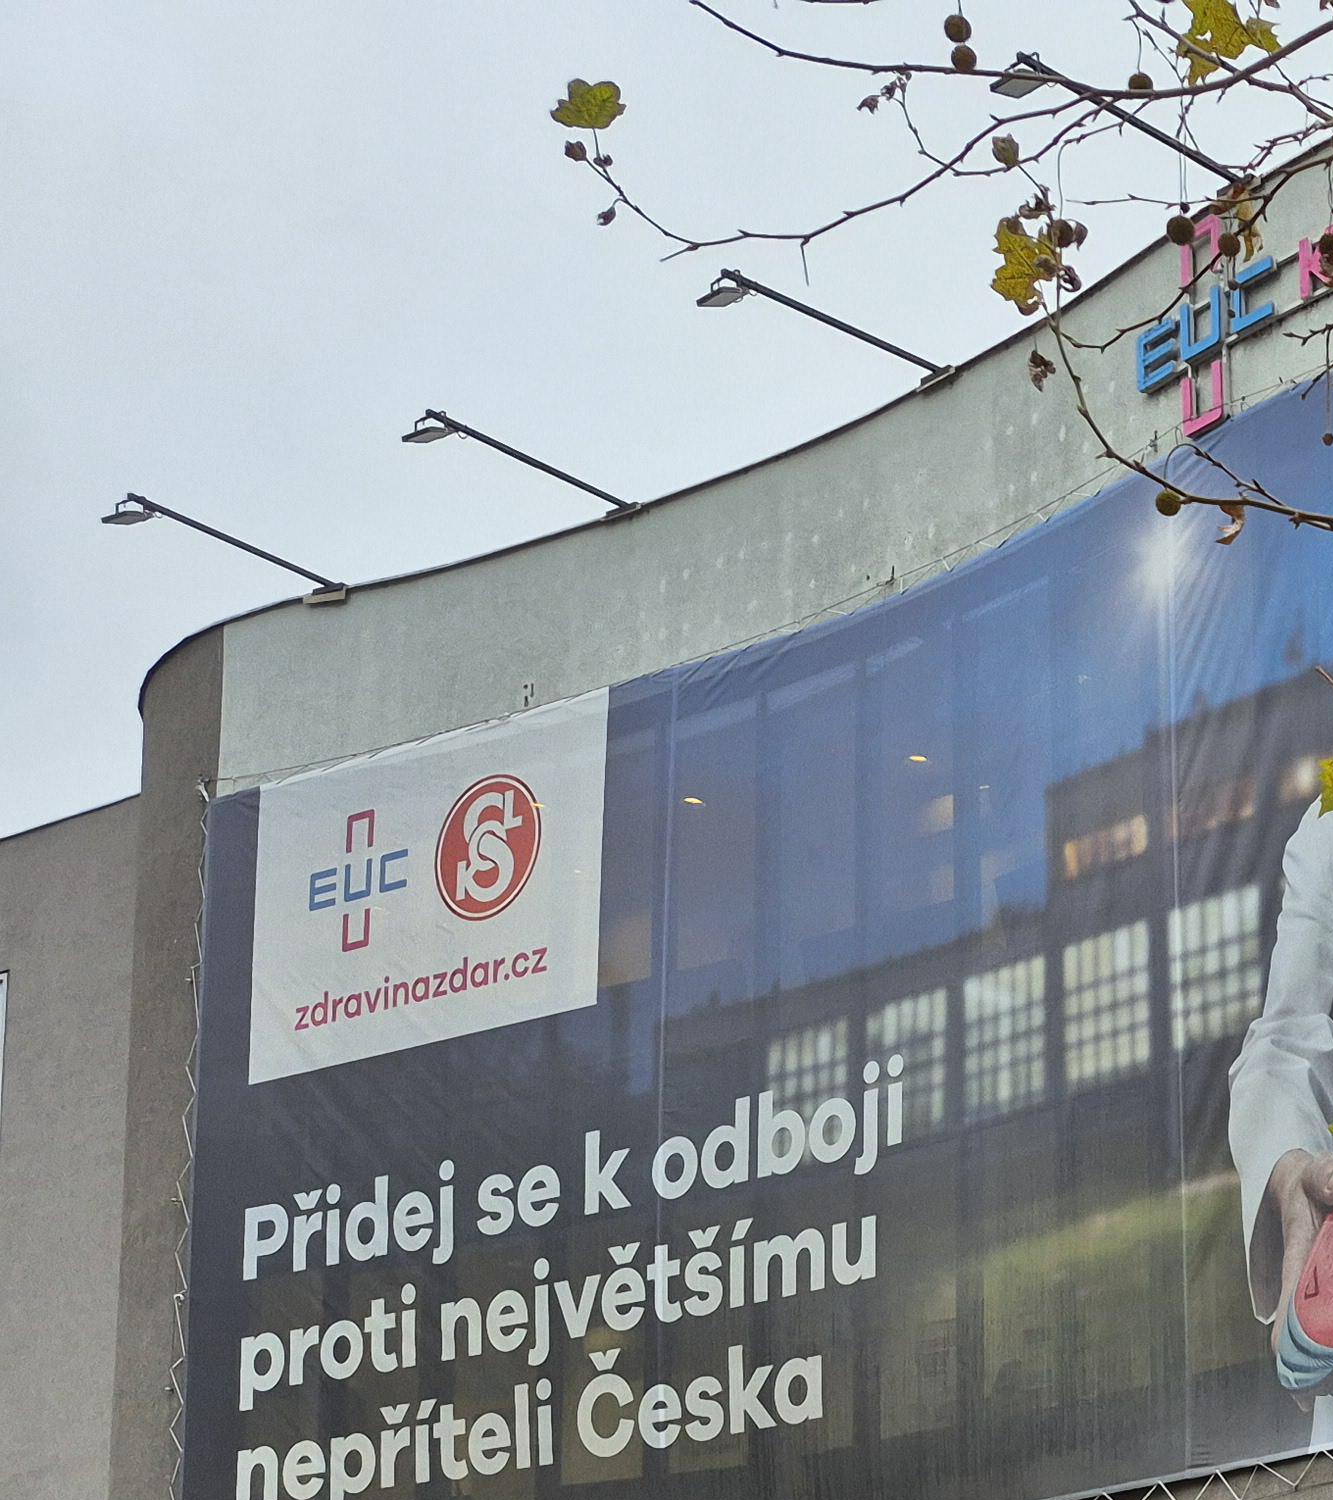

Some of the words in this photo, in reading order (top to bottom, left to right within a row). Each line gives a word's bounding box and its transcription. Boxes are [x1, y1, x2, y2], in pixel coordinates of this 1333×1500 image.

[309, 848, 409, 911] EUC
[293, 947, 548, 1031] zdravinazdar.cz
[243, 1159, 454, 1281] Přidej
[476, 1164, 561, 1236] se
[584, 1130, 632, 1214] k
[652, 1054, 904, 1200] odboji
[239, 1283, 417, 1411] proti
[440, 1215, 877, 1366] největšímu
[577, 1344, 824, 1457] Česka
